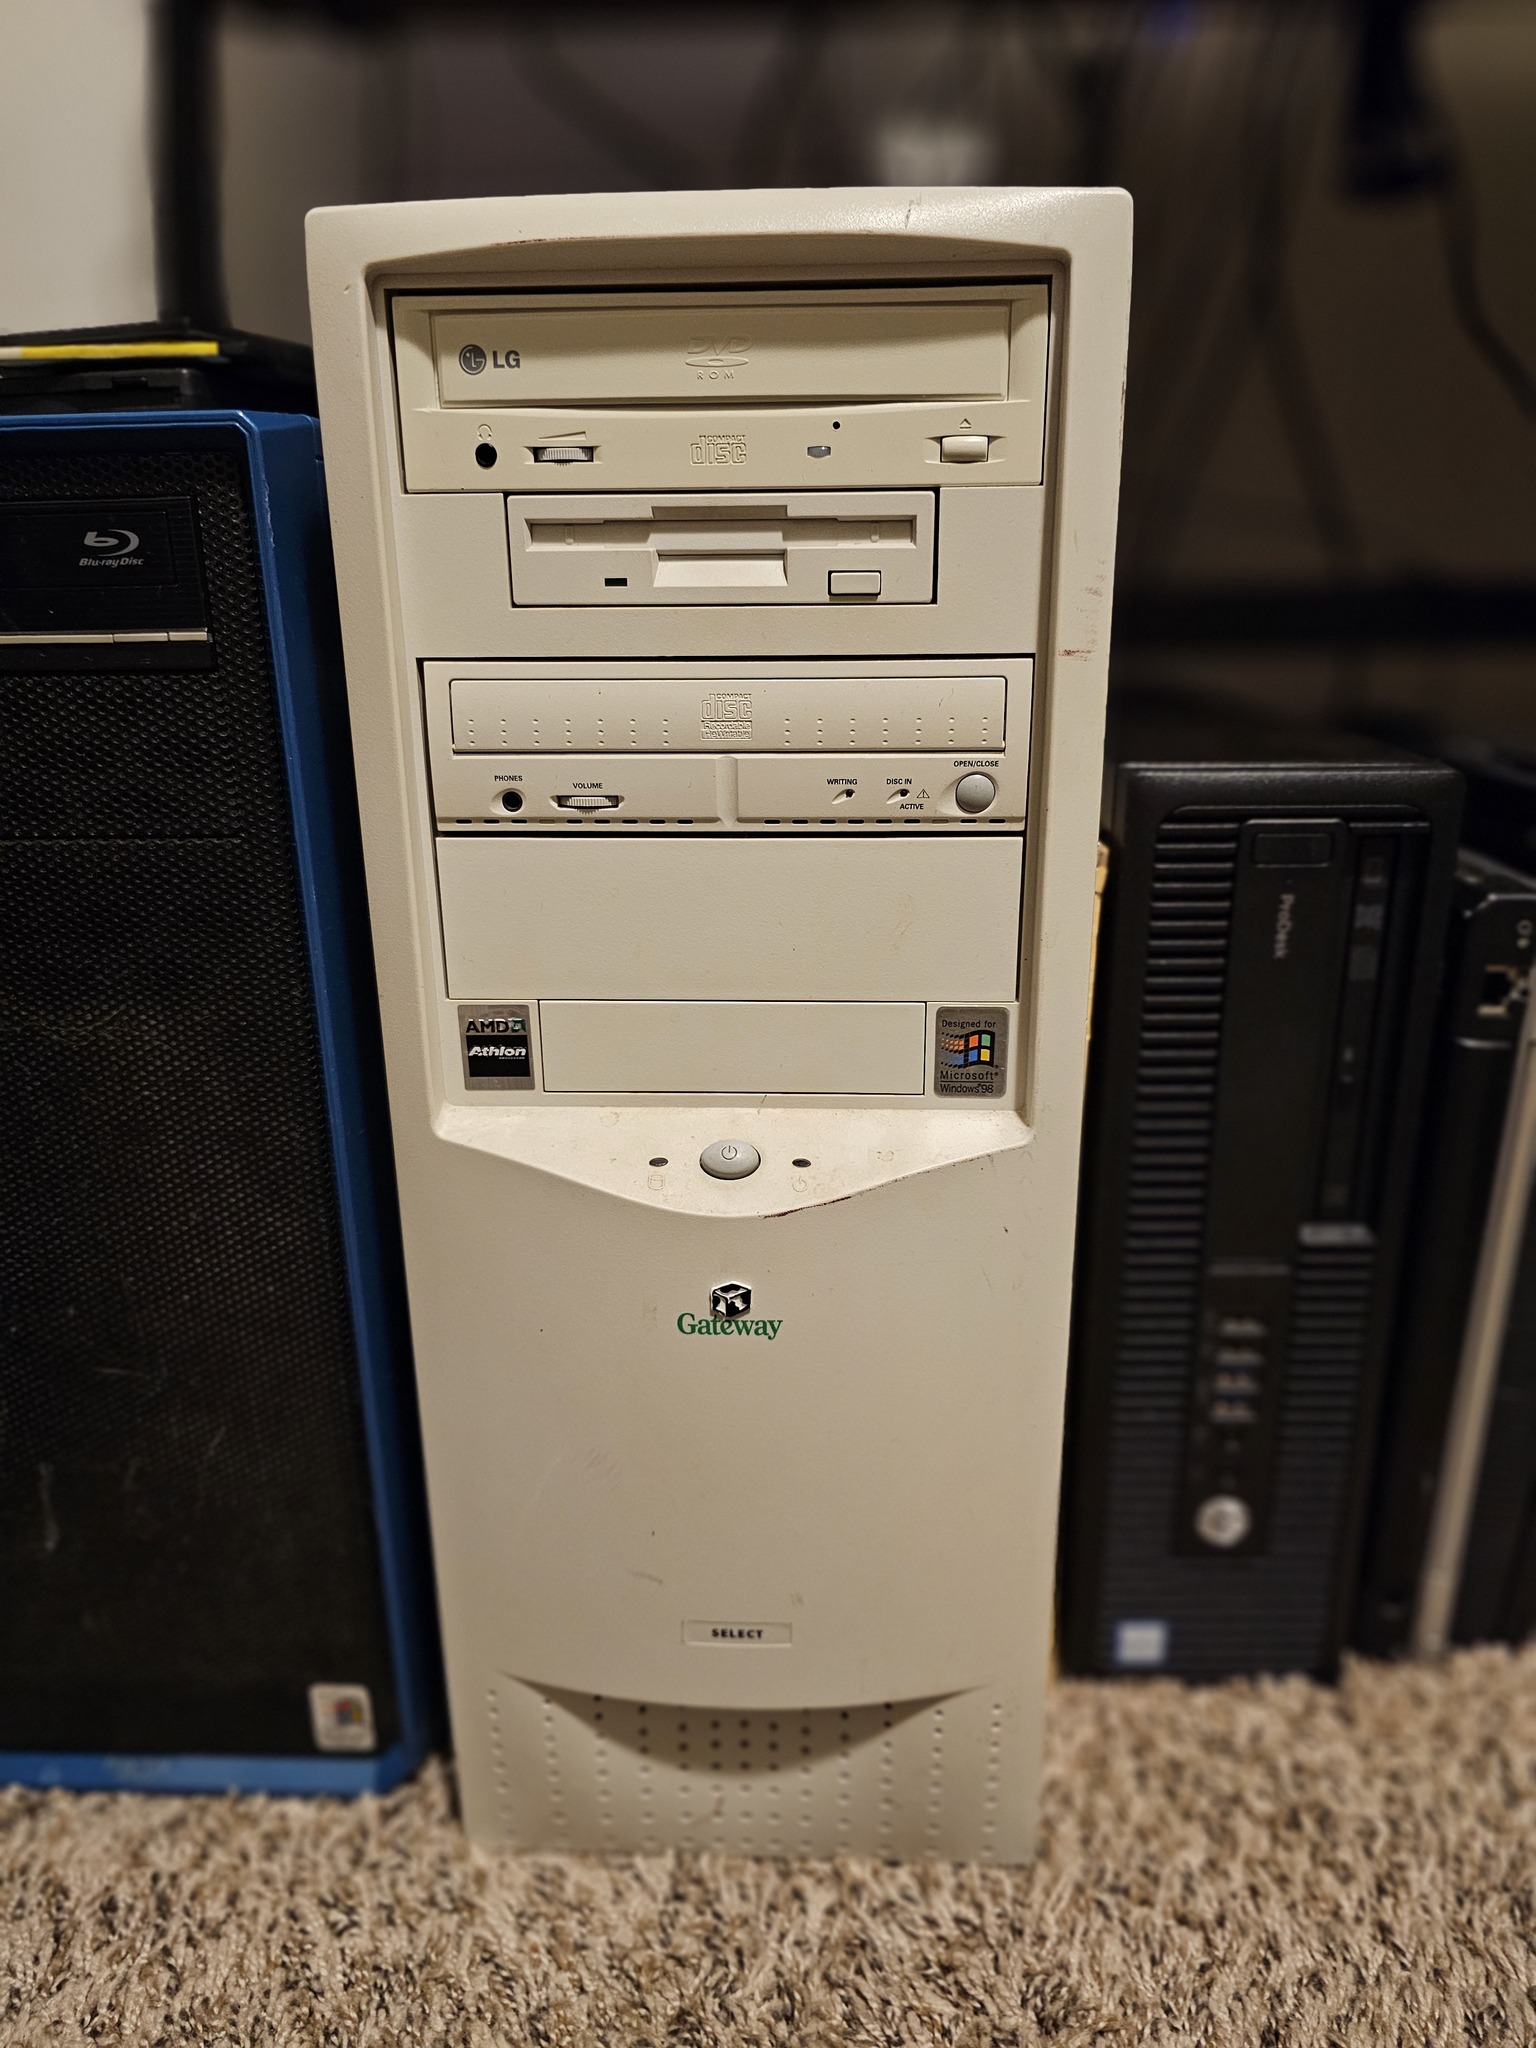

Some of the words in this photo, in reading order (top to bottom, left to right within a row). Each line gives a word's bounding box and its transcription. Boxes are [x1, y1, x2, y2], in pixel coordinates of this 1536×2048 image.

[686, 336, 753, 356] DVD
[492, 350, 520, 369] LG
[696, 370, 735, 380] ROM
[707, 434, 747, 443] COMPACT
[690, 434, 748, 465] disc
[79, 558, 120, 568] Blu-ray
[120, 556, 144, 566] Disc
[701, 693, 752, 719] disc
[953, 760, 999, 768] OPEN/CLOSE
[465, 1018, 509, 1033] AMD
[941, 1019, 981, 1029] Designed
[984, 1019, 996, 1028] for
[468, 1046, 526, 1056] Athlon
[677, 1312, 783, 1340] Gateway
[711, 1628, 763, 1638] SELECT
